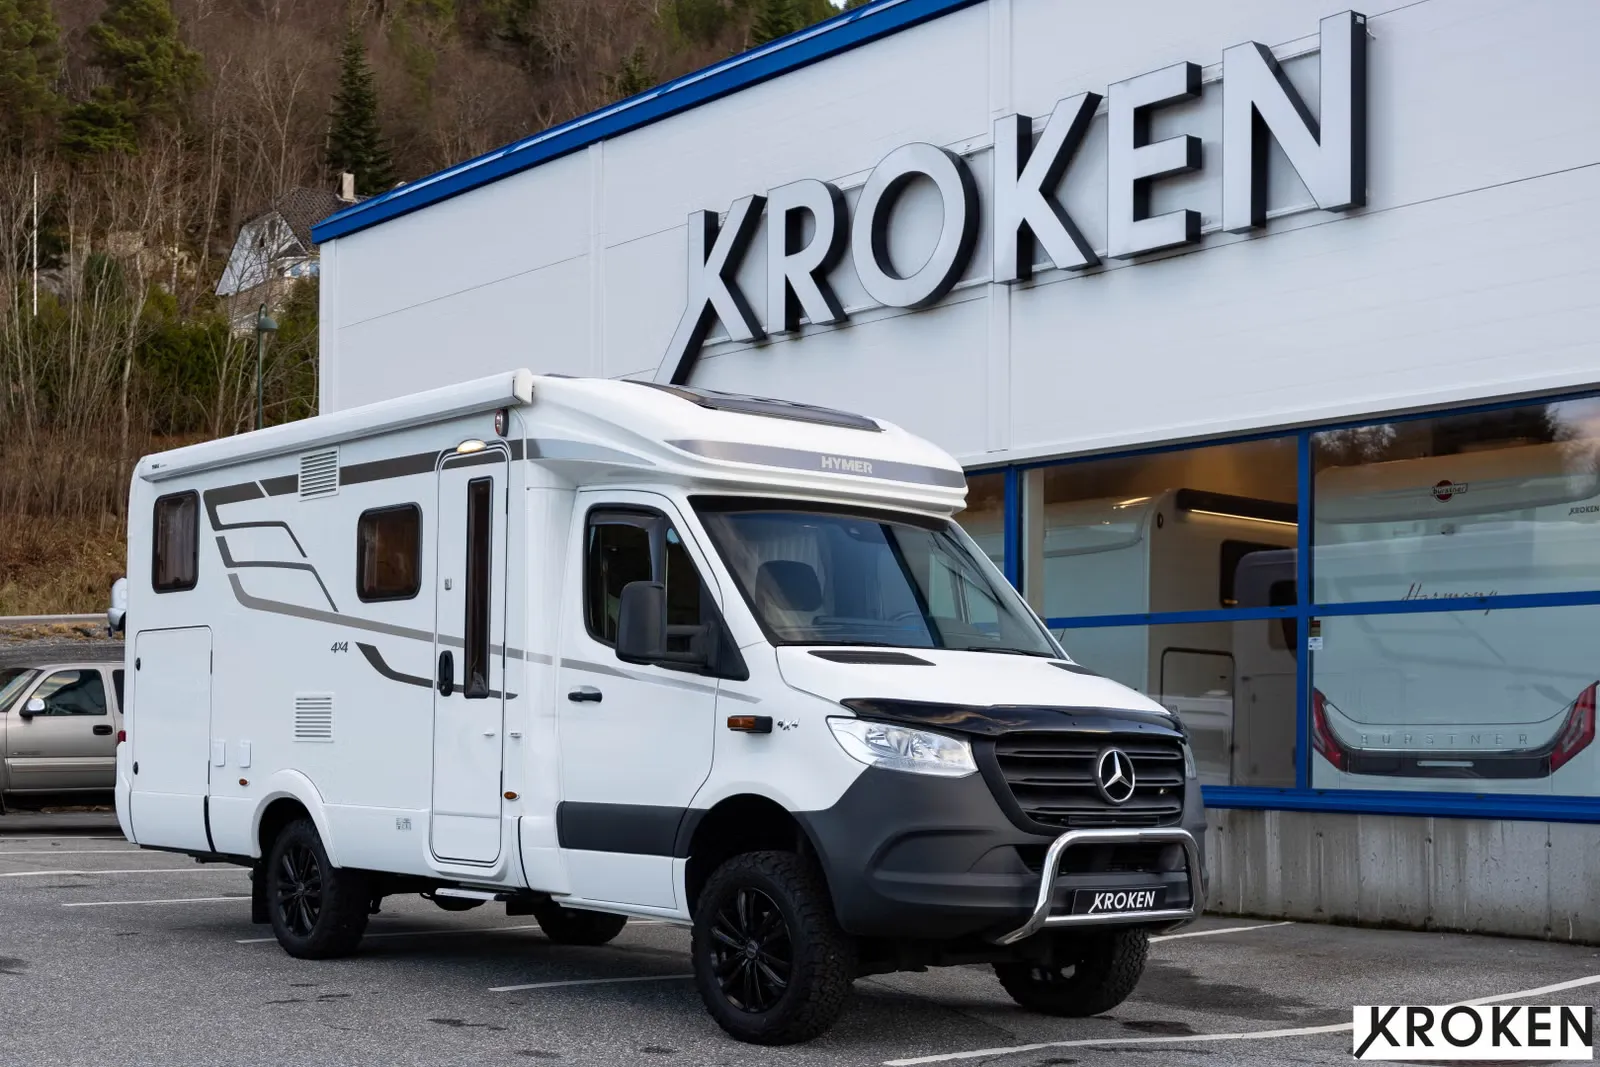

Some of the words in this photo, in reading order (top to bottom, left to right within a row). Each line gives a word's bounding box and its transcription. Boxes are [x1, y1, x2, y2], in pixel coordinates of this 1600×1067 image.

[653, 10, 1367, 385] KROKEN
[821, 455, 873, 474] HYMER
[1087, 890, 1156, 914] KROKEN
